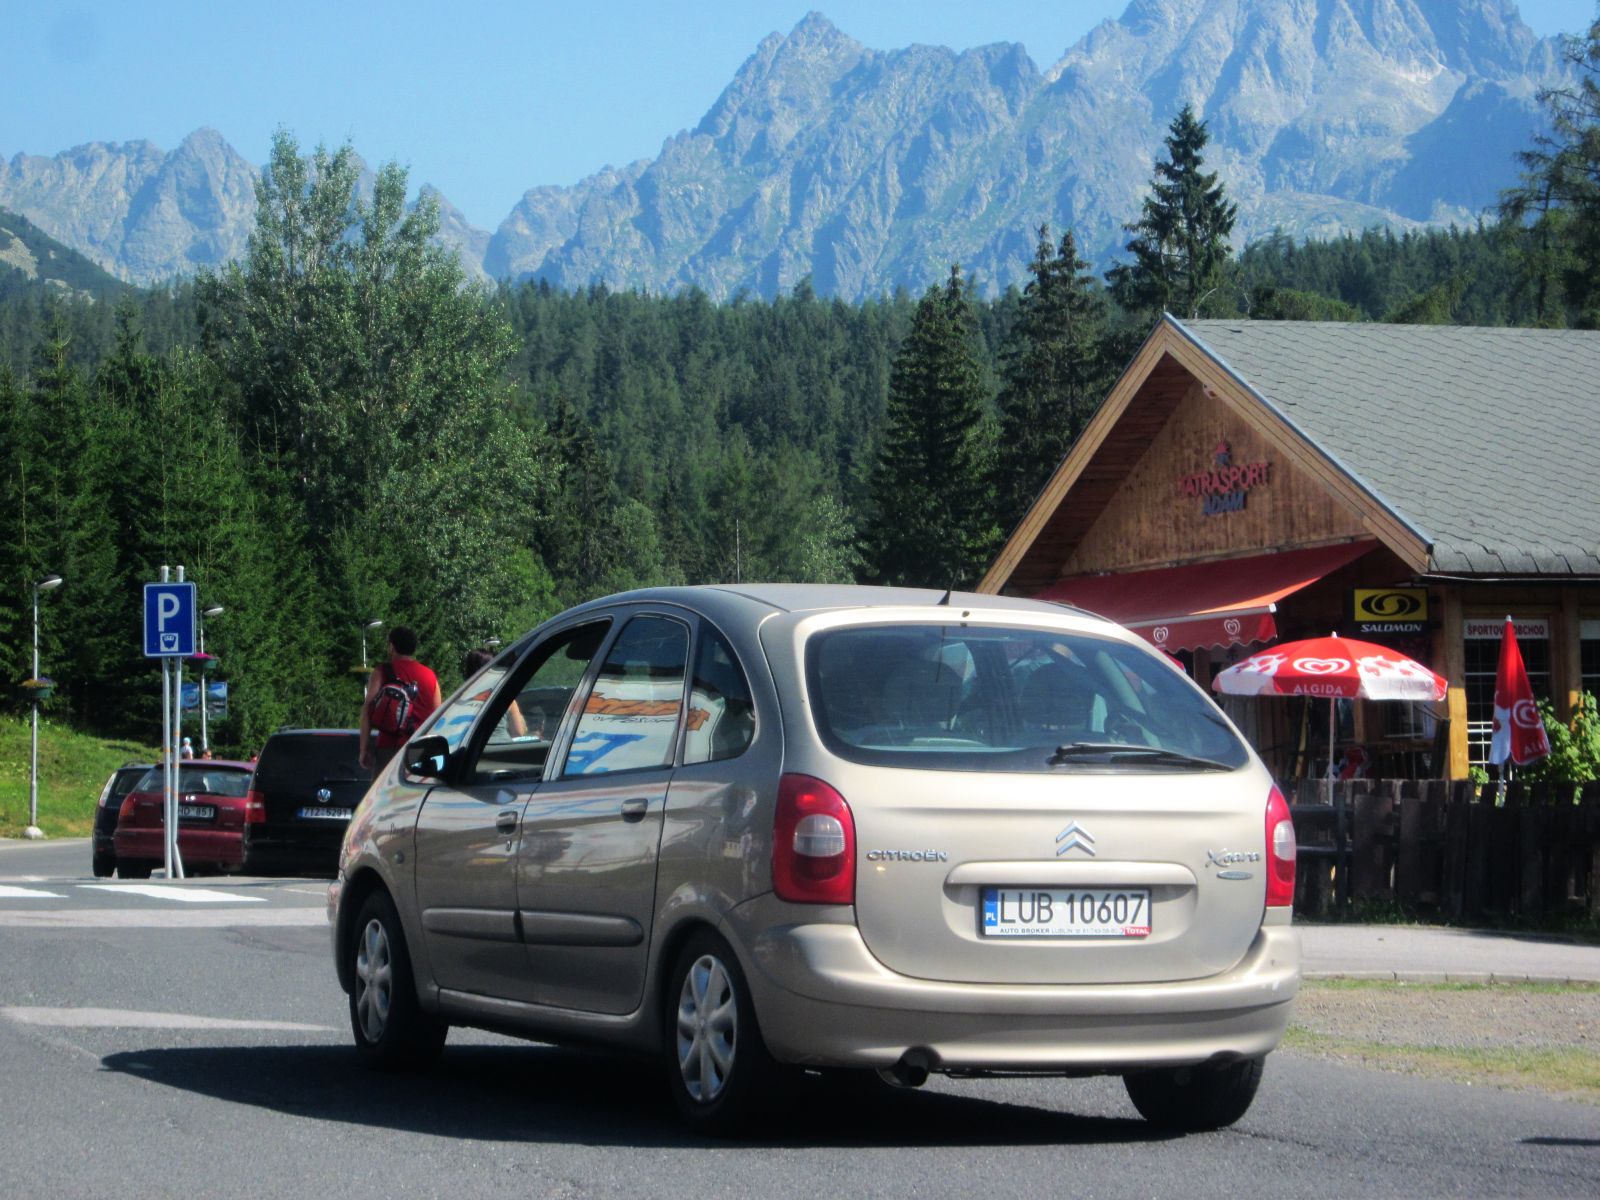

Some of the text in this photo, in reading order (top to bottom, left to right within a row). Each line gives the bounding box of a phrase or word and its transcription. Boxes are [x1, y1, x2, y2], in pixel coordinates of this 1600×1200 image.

[158, 592, 180, 632] P
[1360, 623, 1422, 632] SALOMON
[1467, 623, 1503, 636] ŠPORTOV
[1293, 683, 1343, 695] ALGIDA
[1000, 892, 1145, 924] LUB 10607
[985, 913, 996, 921] PL
[1126, 927, 1150, 935] TOTAL
